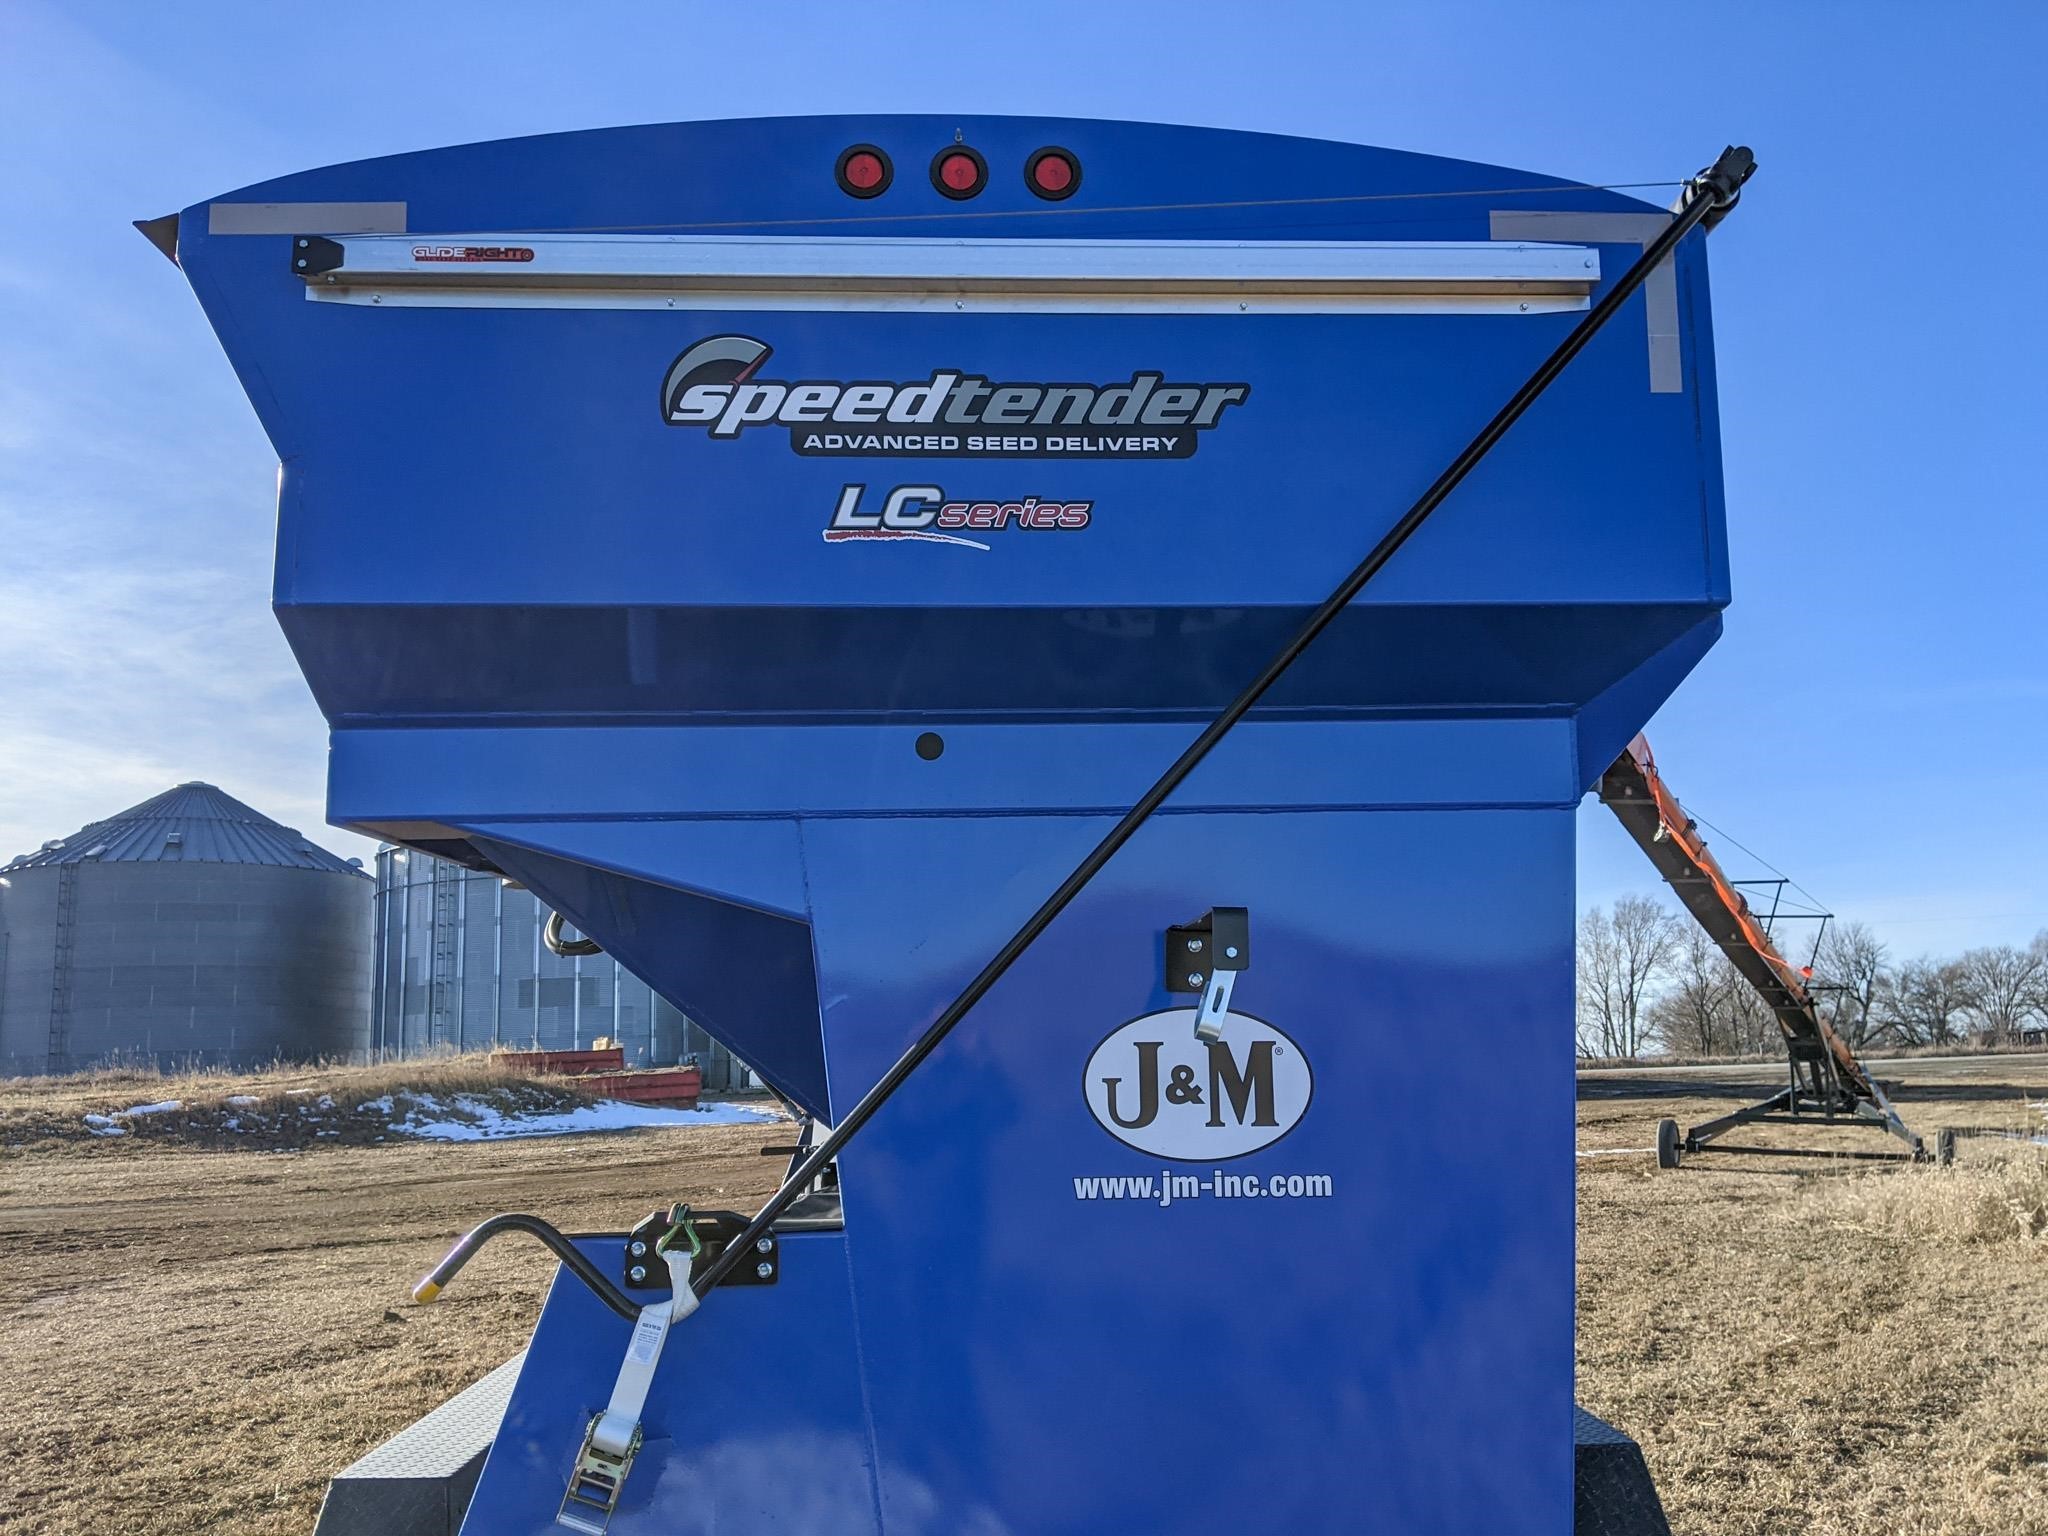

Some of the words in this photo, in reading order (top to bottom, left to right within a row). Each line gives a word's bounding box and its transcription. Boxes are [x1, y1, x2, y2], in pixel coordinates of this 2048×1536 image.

[803, 434, 959, 451] ADVANCED
[967, 435, 1038, 451] SEED
[1046, 436, 1179, 452] DELIVERY
[833, 487, 942, 527] LC
[937, 499, 1090, 528] series
[1073, 1170, 1333, 1207] www.jm-inc.com
